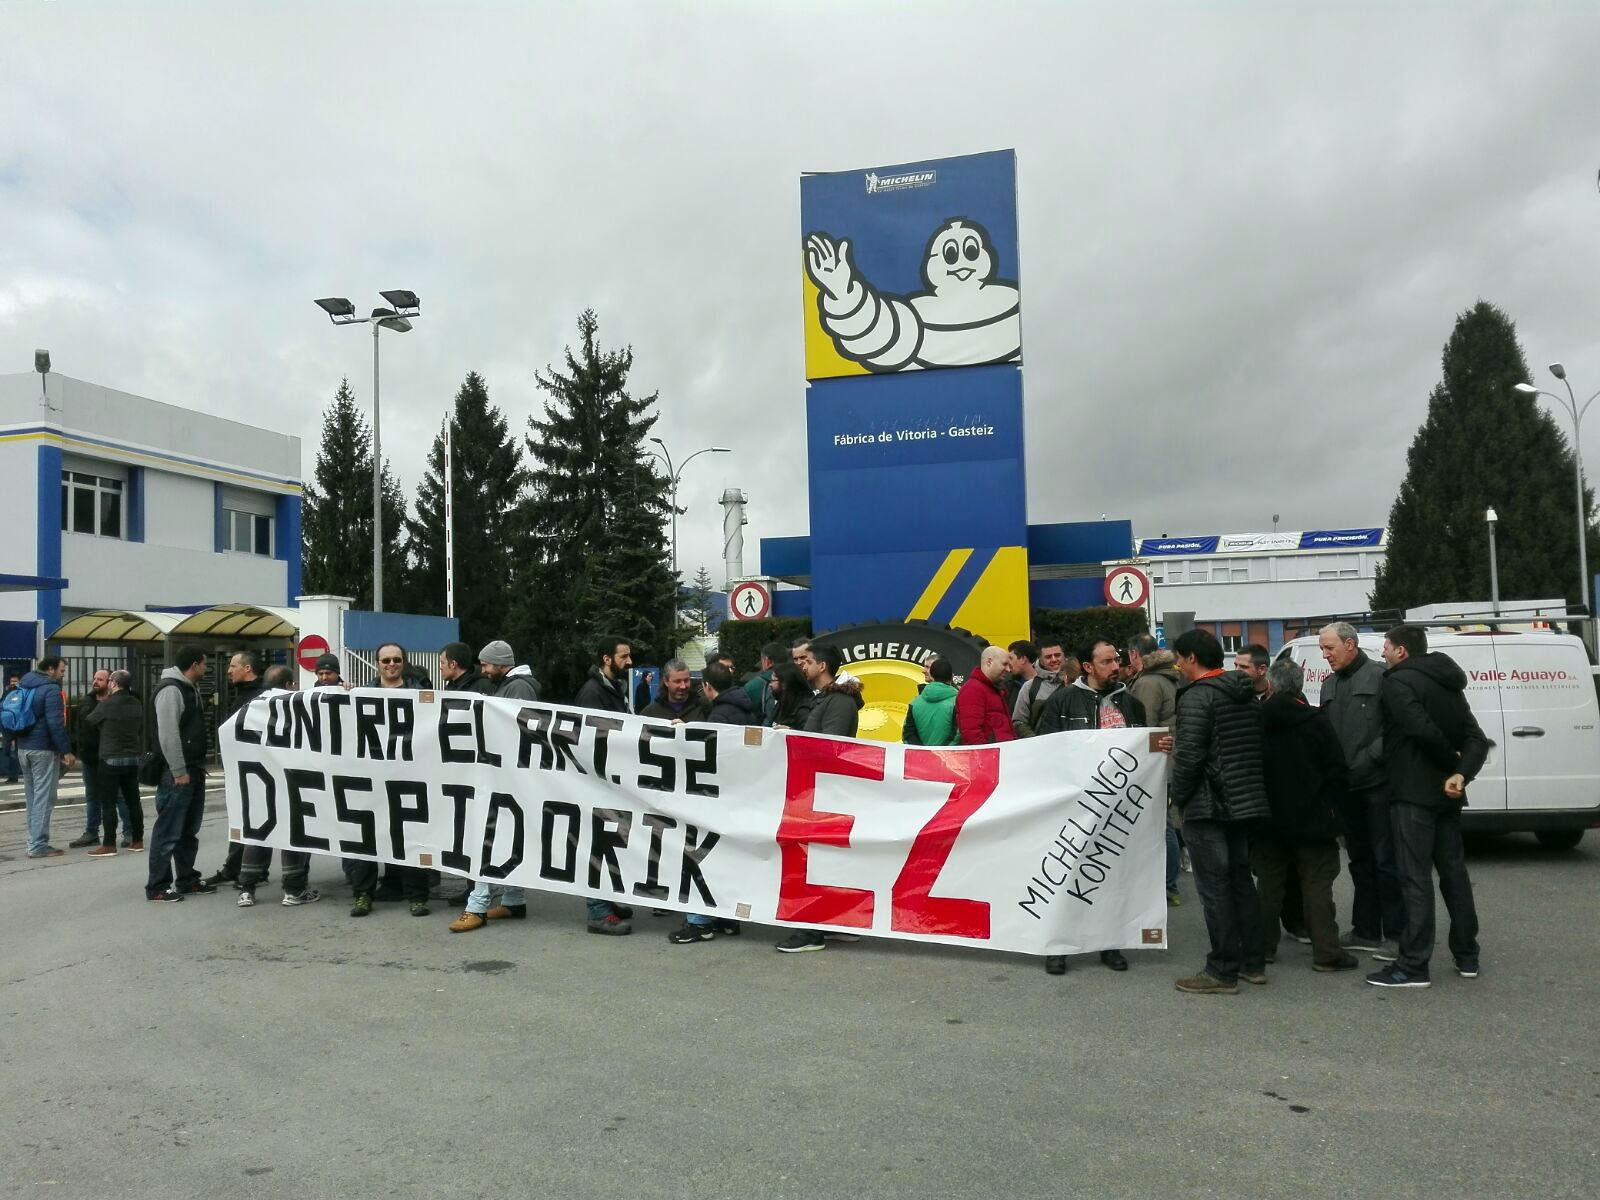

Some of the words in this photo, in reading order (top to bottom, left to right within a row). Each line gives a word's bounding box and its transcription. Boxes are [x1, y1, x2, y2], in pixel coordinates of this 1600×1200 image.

[880, 173, 934, 186] MICHELIN
[834, 433, 875, 446] Fábrica
[878, 432, 892, 442] de
[896, 428, 937, 441] Vitoria
[949, 425, 994, 437] Gasteiz
[840, 642, 938, 664] ICHELIN
[1306, 668, 1316, 682] Del
[1317, 668, 1334, 682] Vall
[1469, 669, 1507, 682] Valle
[1511, 669, 1567, 683] Aguayo
[235, 691, 414, 761] CONTRA
[439, 698, 502, 769] EL
[517, 707, 625, 785] ART.
[638, 724, 719, 798] 52
[237, 761, 721, 909] DESPIDORIK
[776, 734, 1000, 940] EZ
[1018, 747, 1139, 920] MICHELINGO
[1067, 784, 1153, 905] KOMITEA
